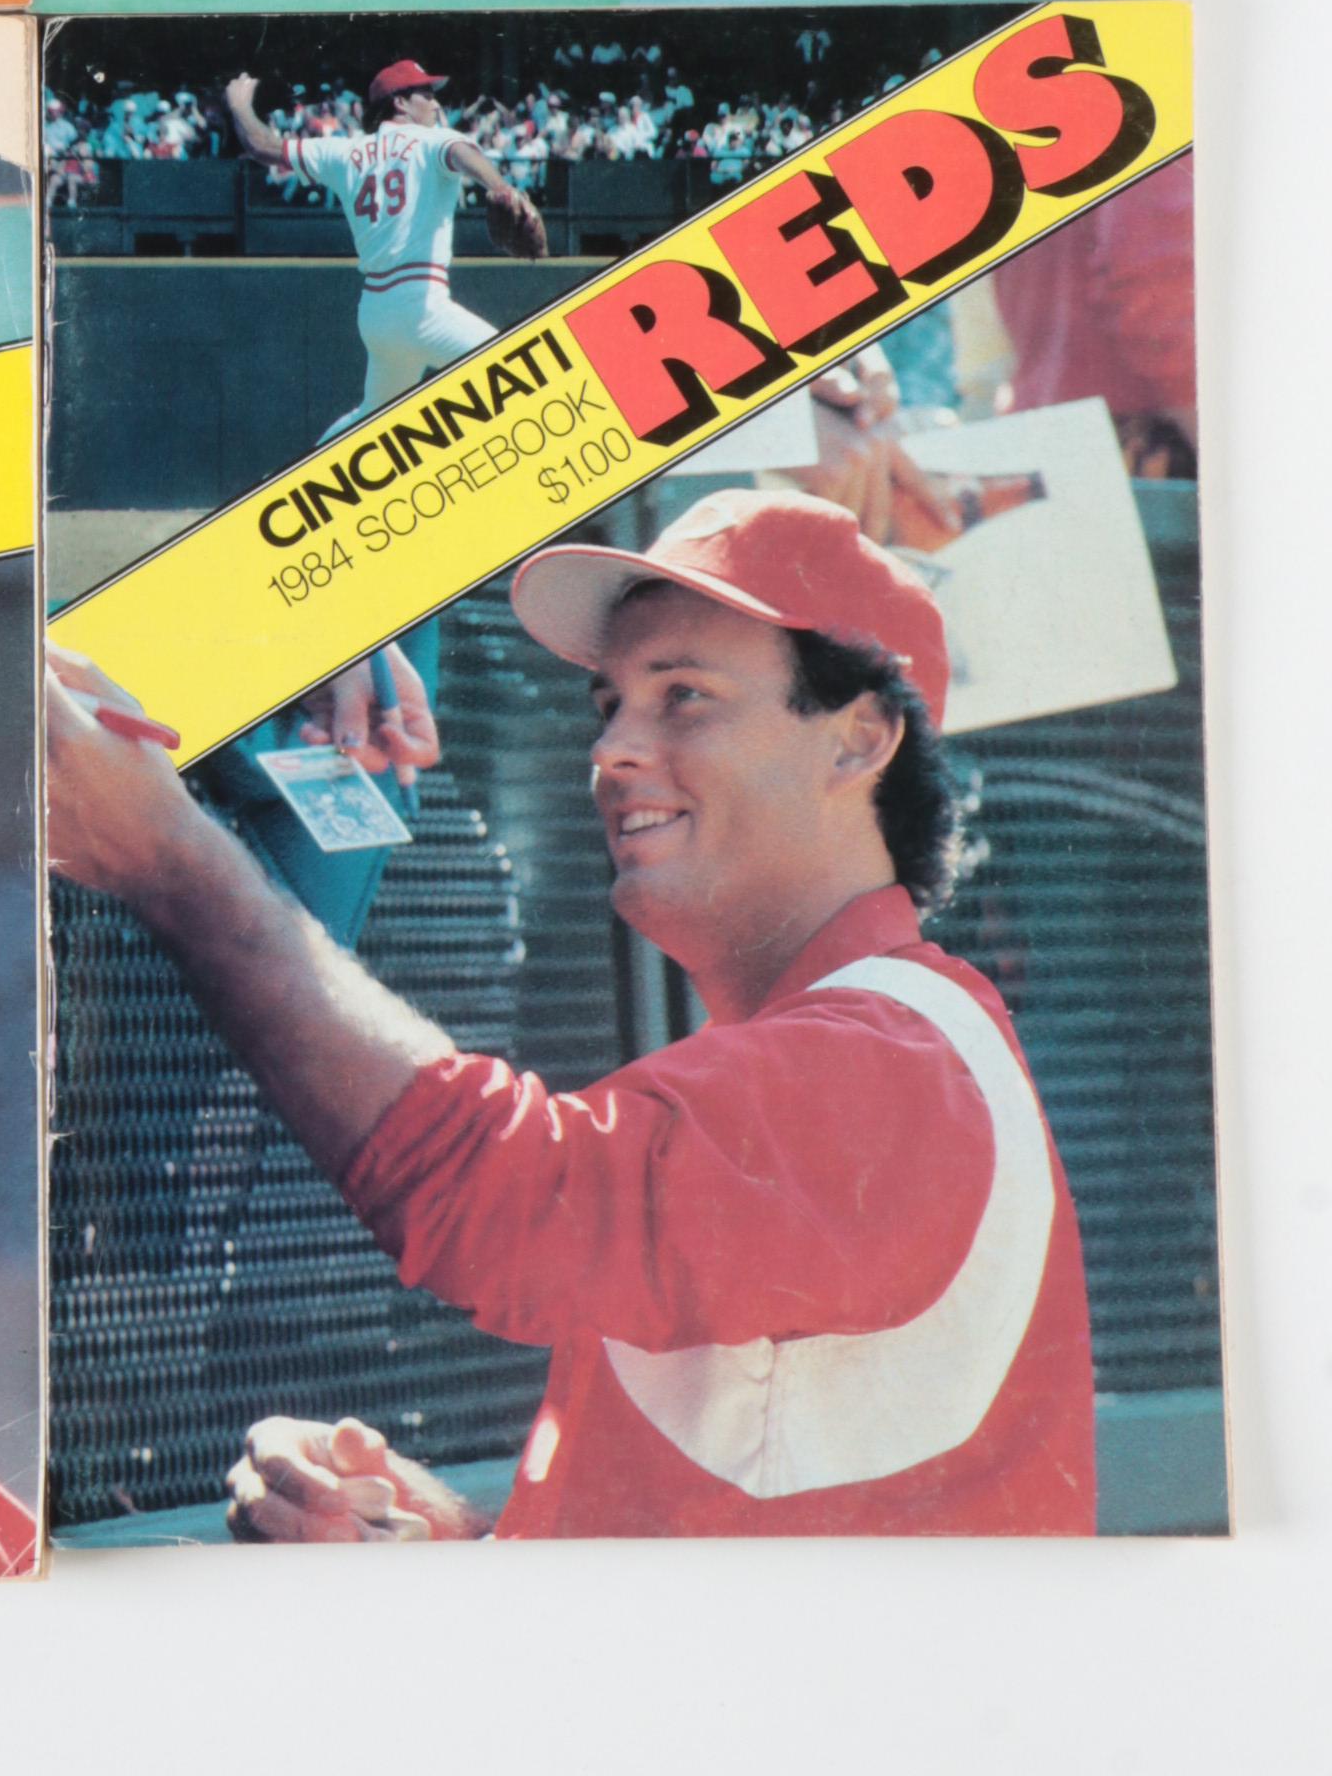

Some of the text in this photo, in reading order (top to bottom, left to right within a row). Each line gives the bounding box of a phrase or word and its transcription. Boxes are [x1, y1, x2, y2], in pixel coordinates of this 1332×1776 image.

[354, 169, 407, 223] 49
[564, 14, 1156, 447] REDS
[258, 328, 574, 548] CINCINNATI
[268, 379, 607, 608] 1984 SCOREBOOK
[537, 426, 632, 505] $1.00
